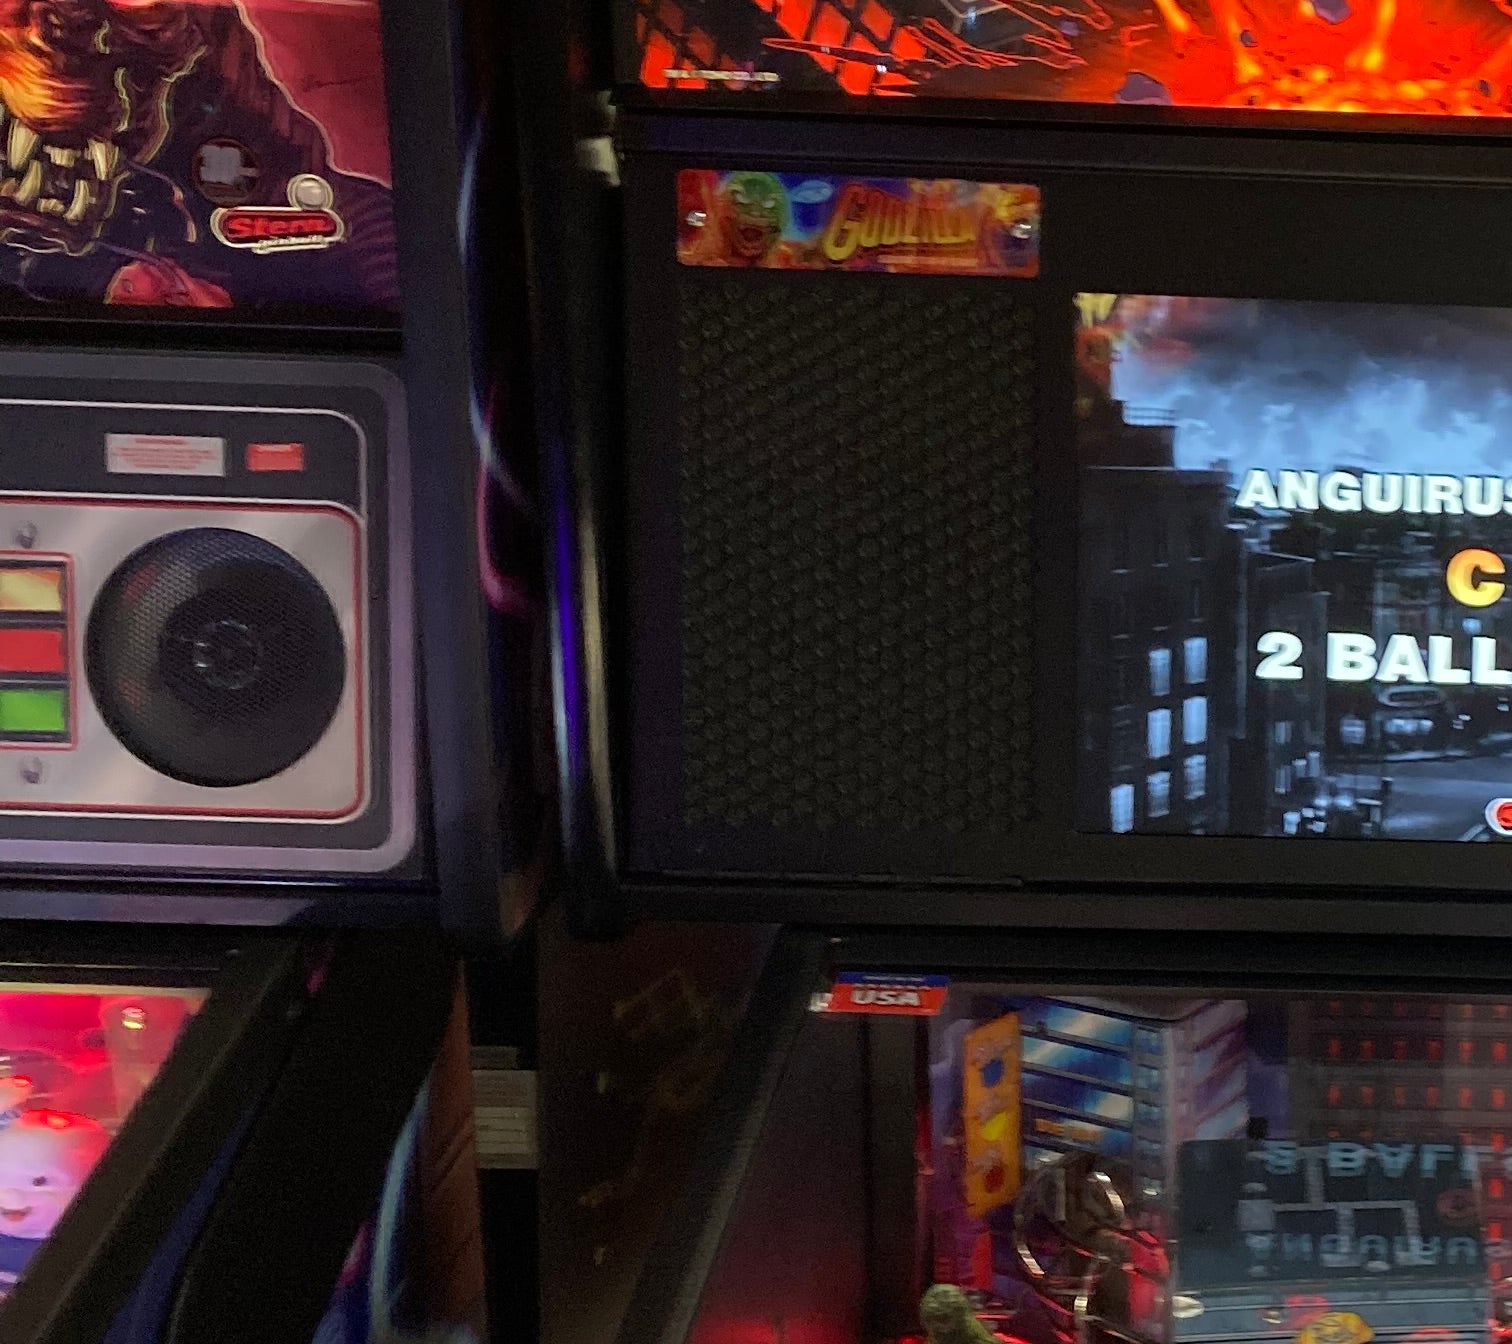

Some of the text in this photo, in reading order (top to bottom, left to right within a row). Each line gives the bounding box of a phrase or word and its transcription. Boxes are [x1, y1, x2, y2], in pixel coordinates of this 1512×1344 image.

[1445, 547, 1506, 608] C
[1254, 631, 1304, 681] 2
[851, 989, 920, 1006] USA
